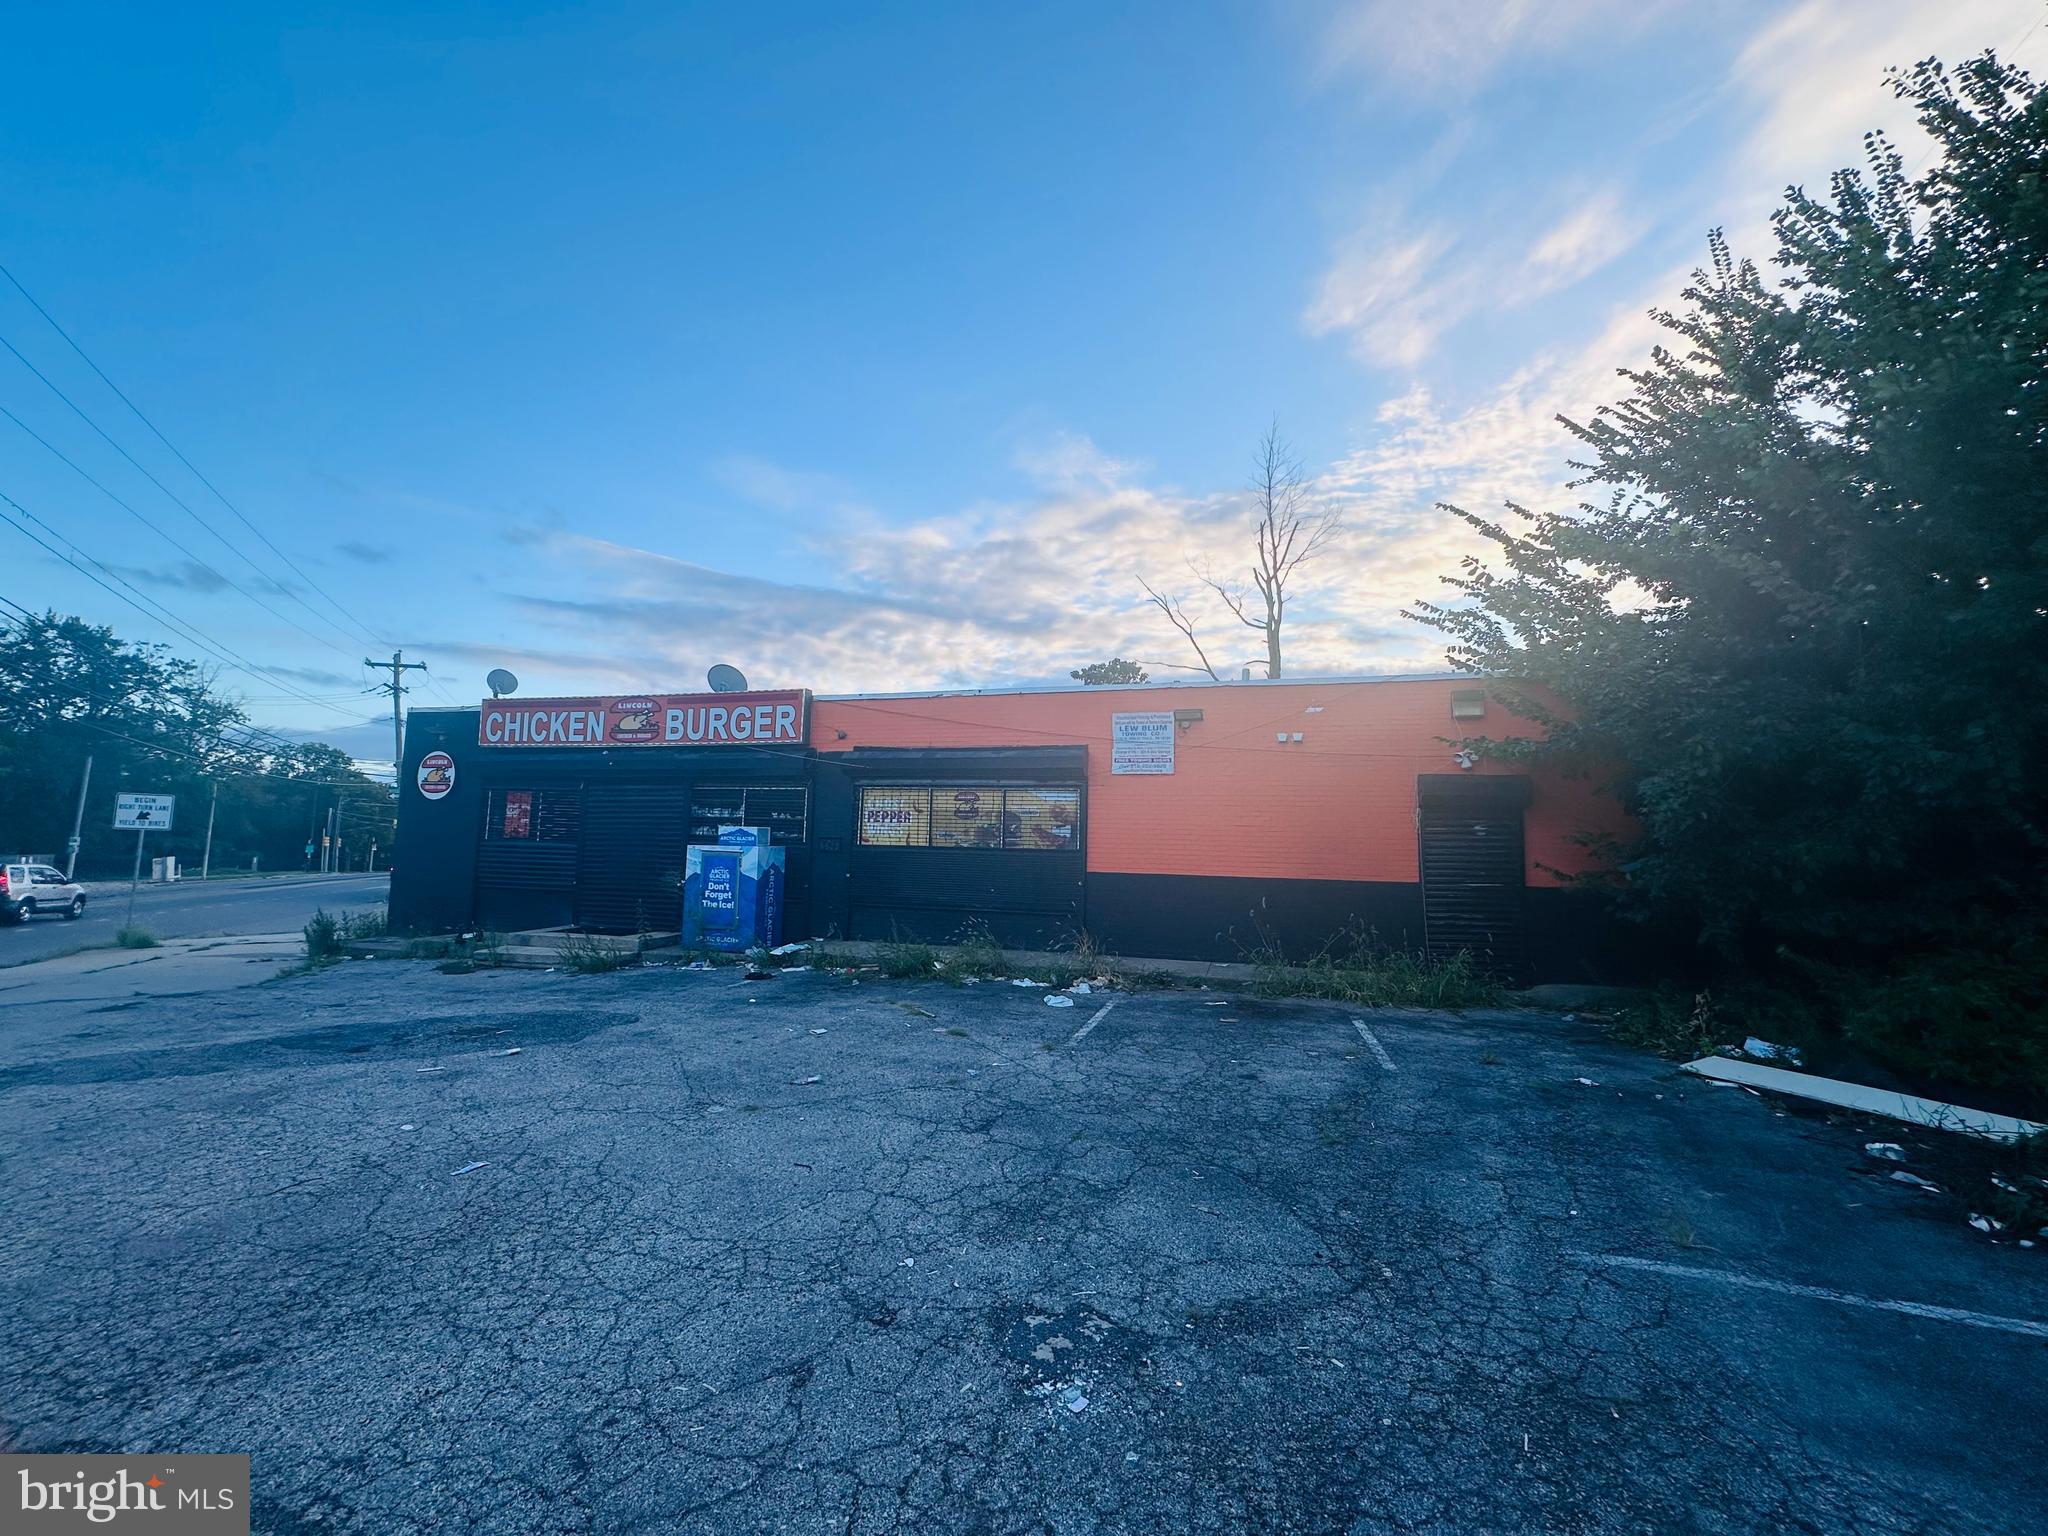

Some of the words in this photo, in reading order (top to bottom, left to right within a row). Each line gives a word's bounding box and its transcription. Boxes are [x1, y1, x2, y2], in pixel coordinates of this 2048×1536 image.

[485, 710, 605, 743] CHICKEN
[664, 704, 797, 741] BURGER
[867, 810, 912, 823] PEPPER
[708, 882, 730, 891] Don't
[705, 890, 732, 900] Forget
[702, 899, 718, 908] The
[719, 900, 735, 909] Ice!
